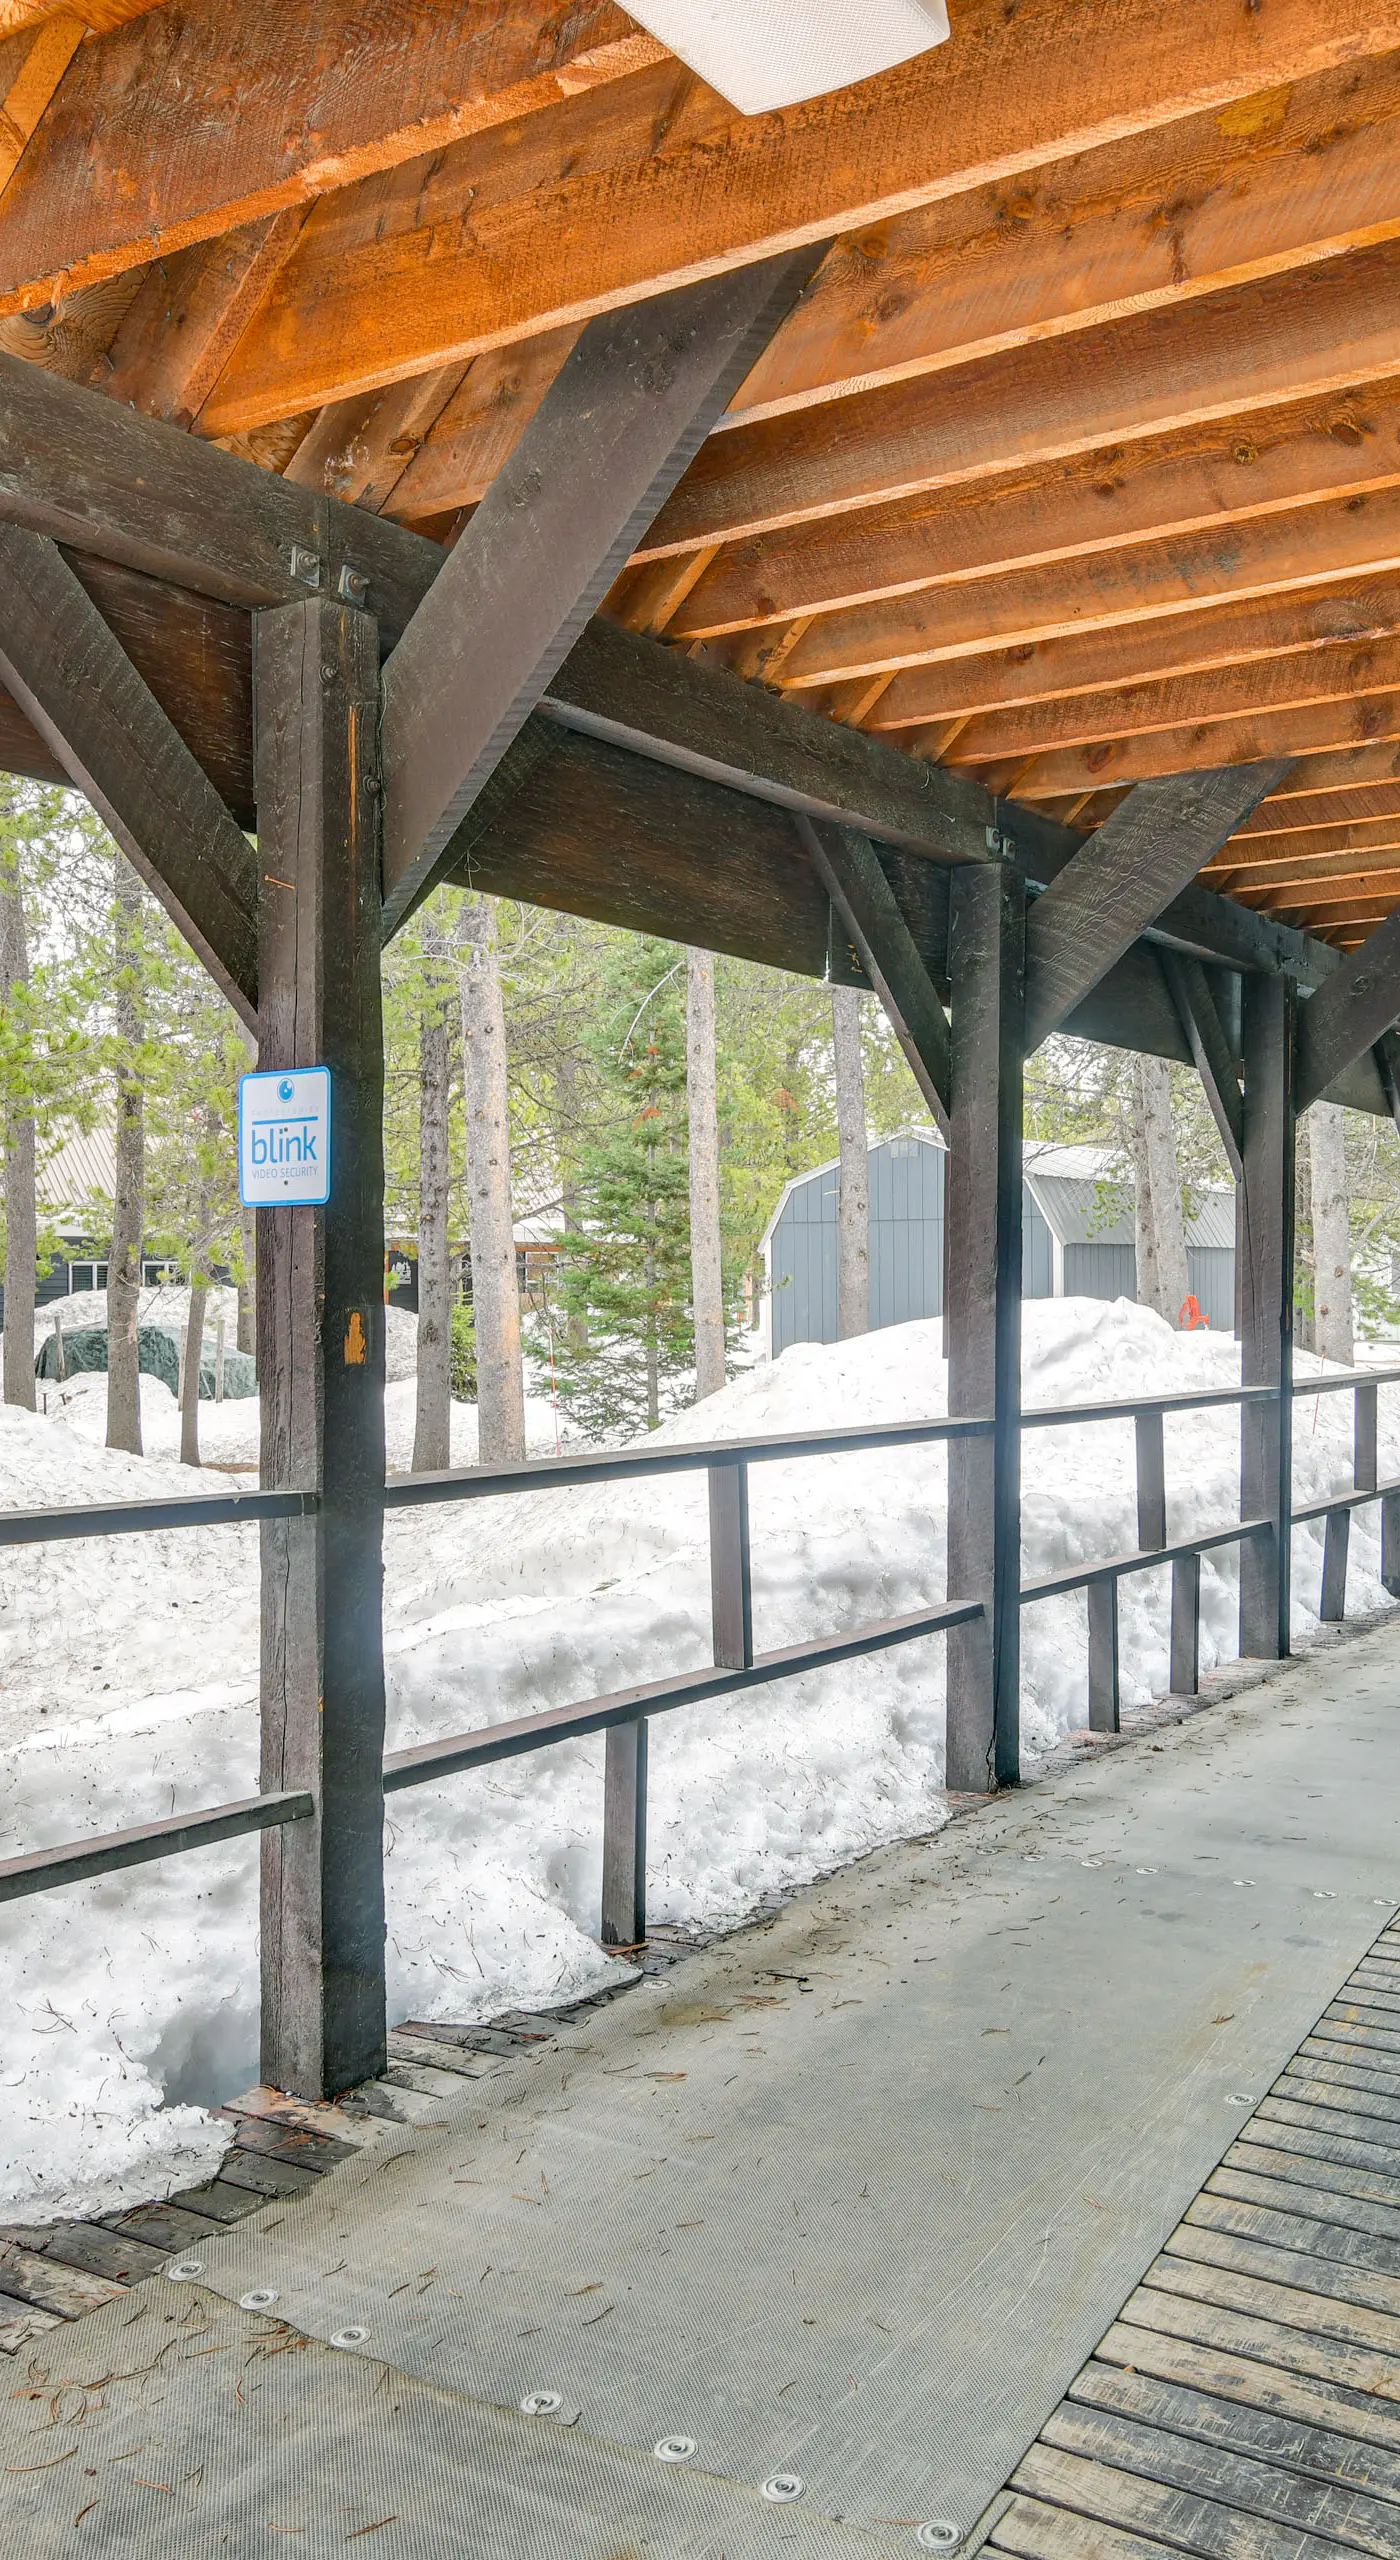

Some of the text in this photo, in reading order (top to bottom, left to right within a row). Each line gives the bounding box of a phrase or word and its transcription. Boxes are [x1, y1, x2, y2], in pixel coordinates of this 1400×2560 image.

[252, 1126, 317, 1164] blink
[252, 1166, 318, 1179] VIDEO SECURITY
